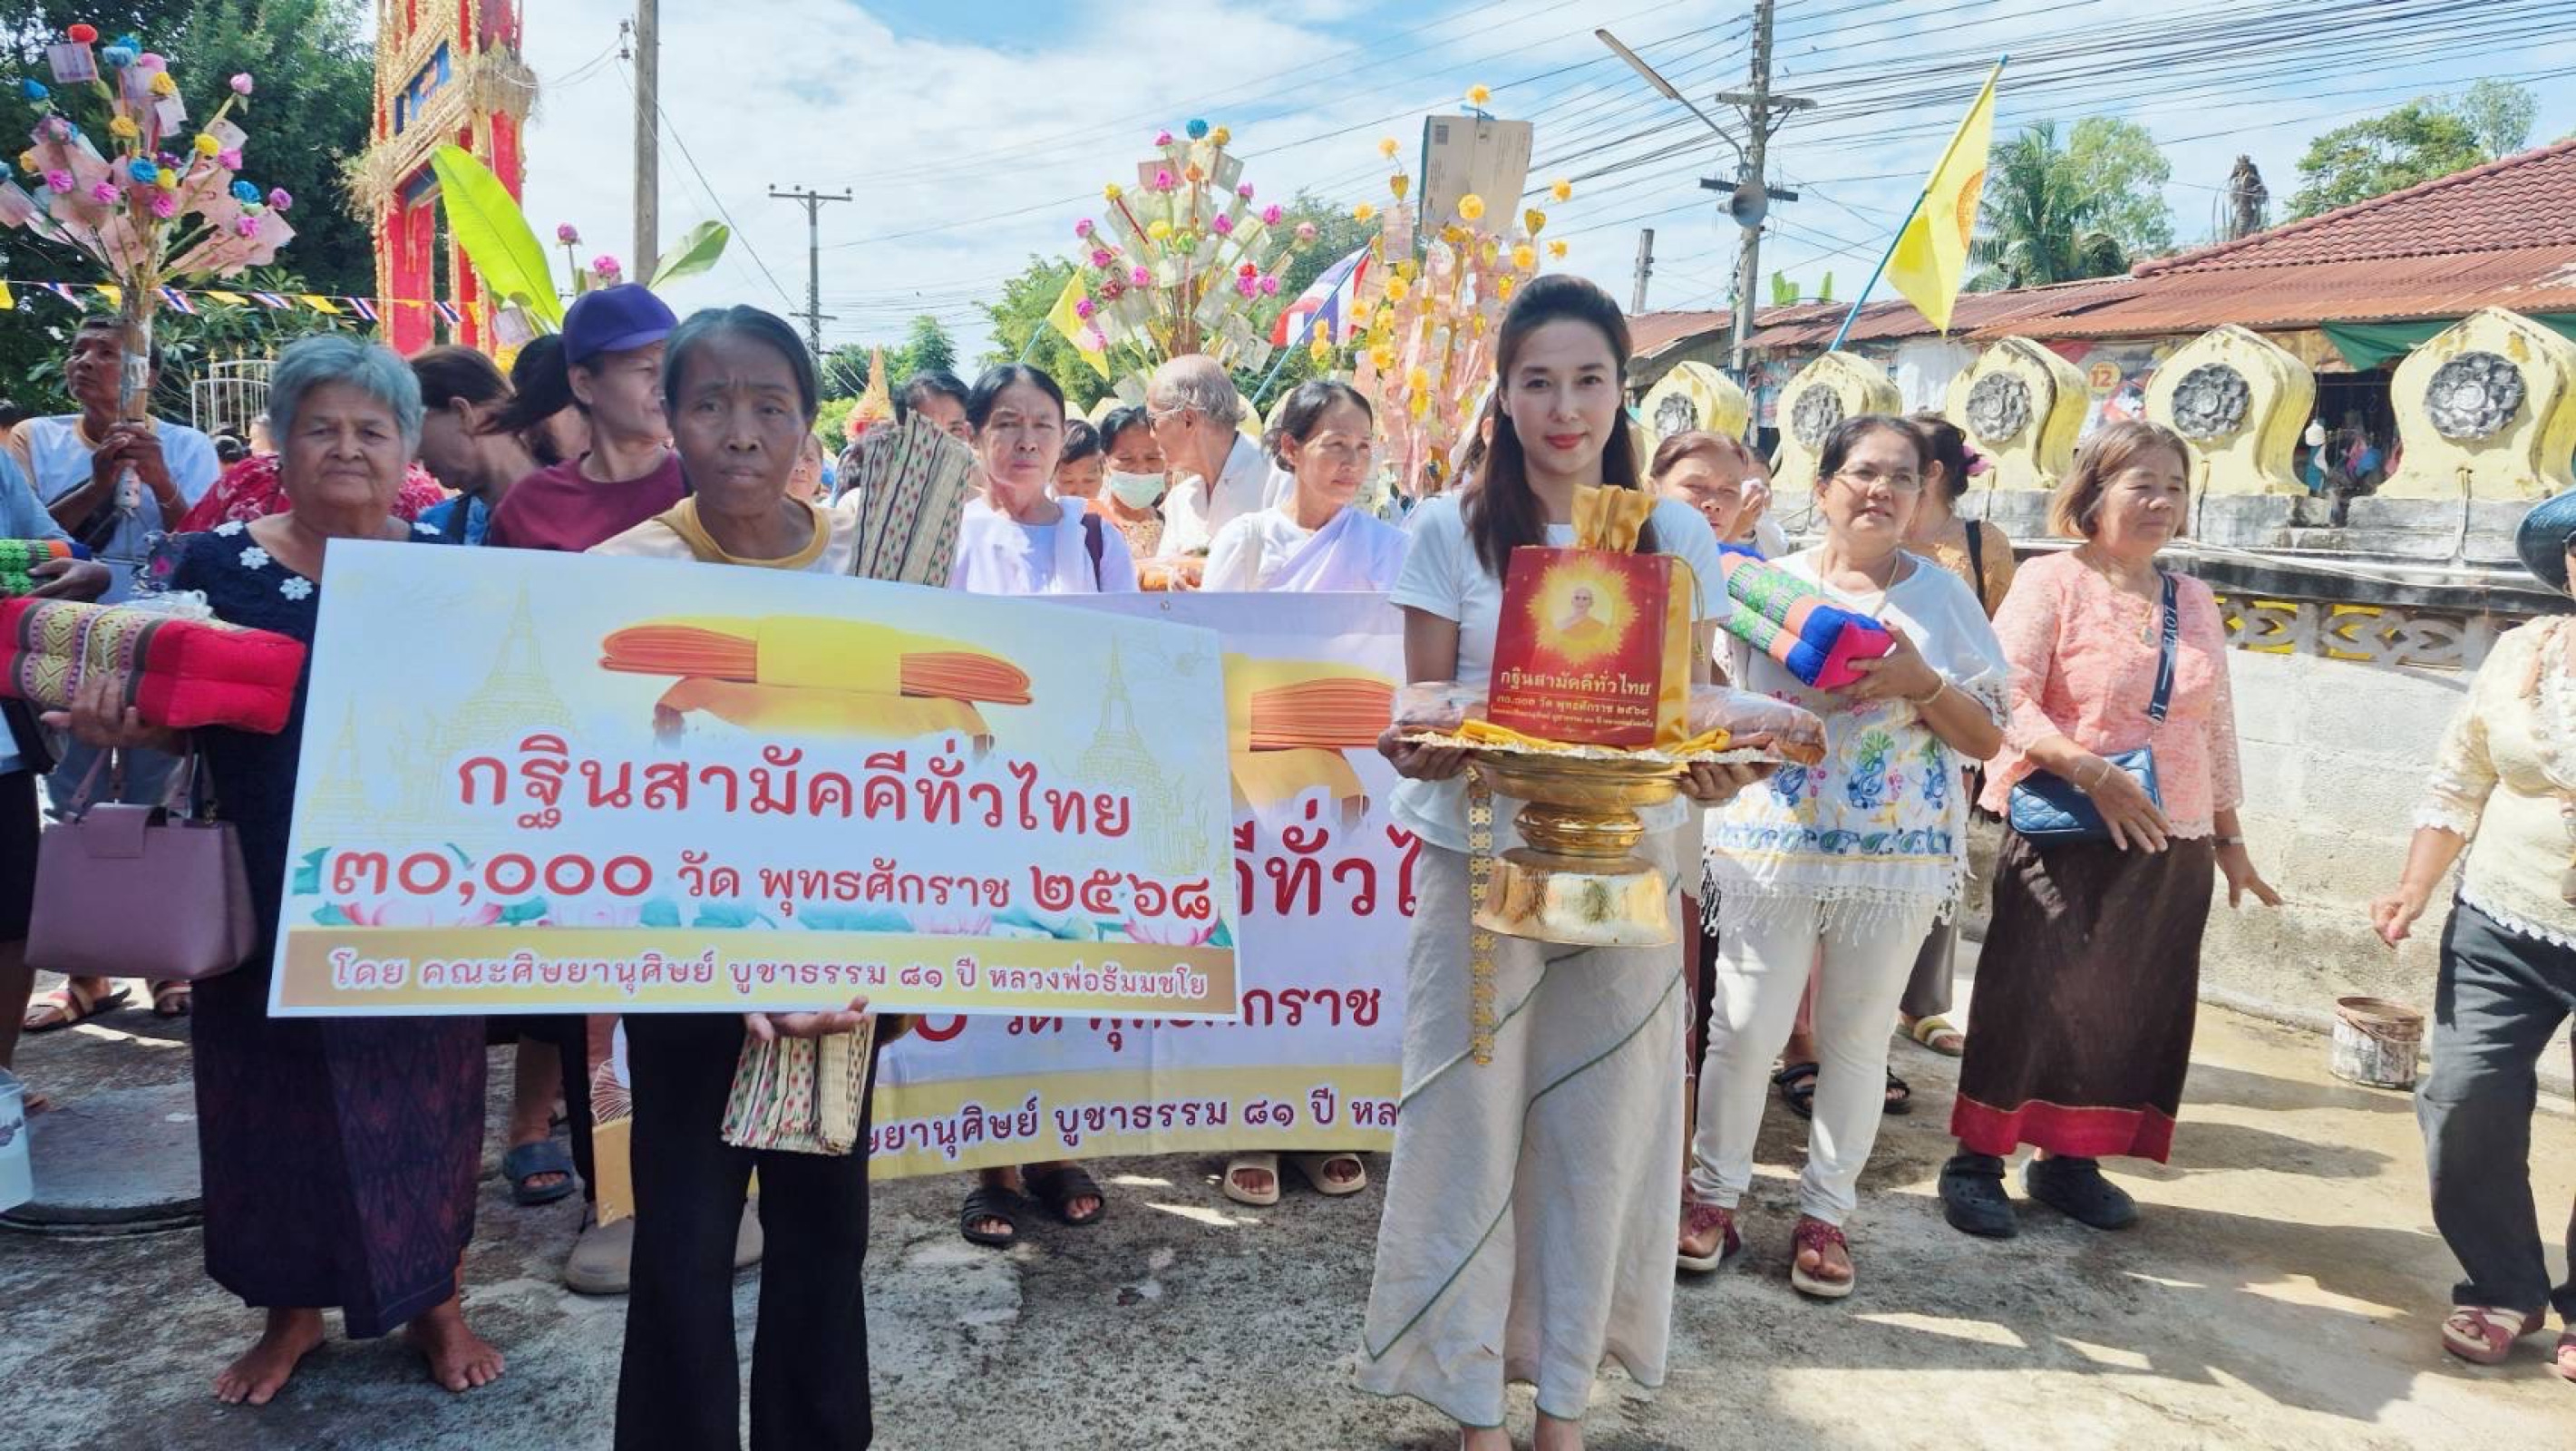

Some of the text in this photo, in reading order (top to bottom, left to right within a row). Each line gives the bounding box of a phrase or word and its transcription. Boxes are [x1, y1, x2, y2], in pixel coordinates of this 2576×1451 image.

[2091, 369, 2113, 388] 12
[459, 734, 1130, 836] กฐินสามัคคีทั่วไทย
[332, 850, 1211, 920] ๓๐,๐๐๐ วัด พุทธศักราช ๒๕๖๘
[335, 950, 1207, 996] โดย คณะศิษยานุศิษย์ บูชาธรรม ๘๑ ปี หลวงพ่อธัมมชโย
[1055, 1101, 1228, 1147] บูชาธรรม
[1243, 1099, 1295, 1127] ๘๑
[1311, 1086, 1336, 1125] ปี
[1351, 1100, 1400, 1126] หล
